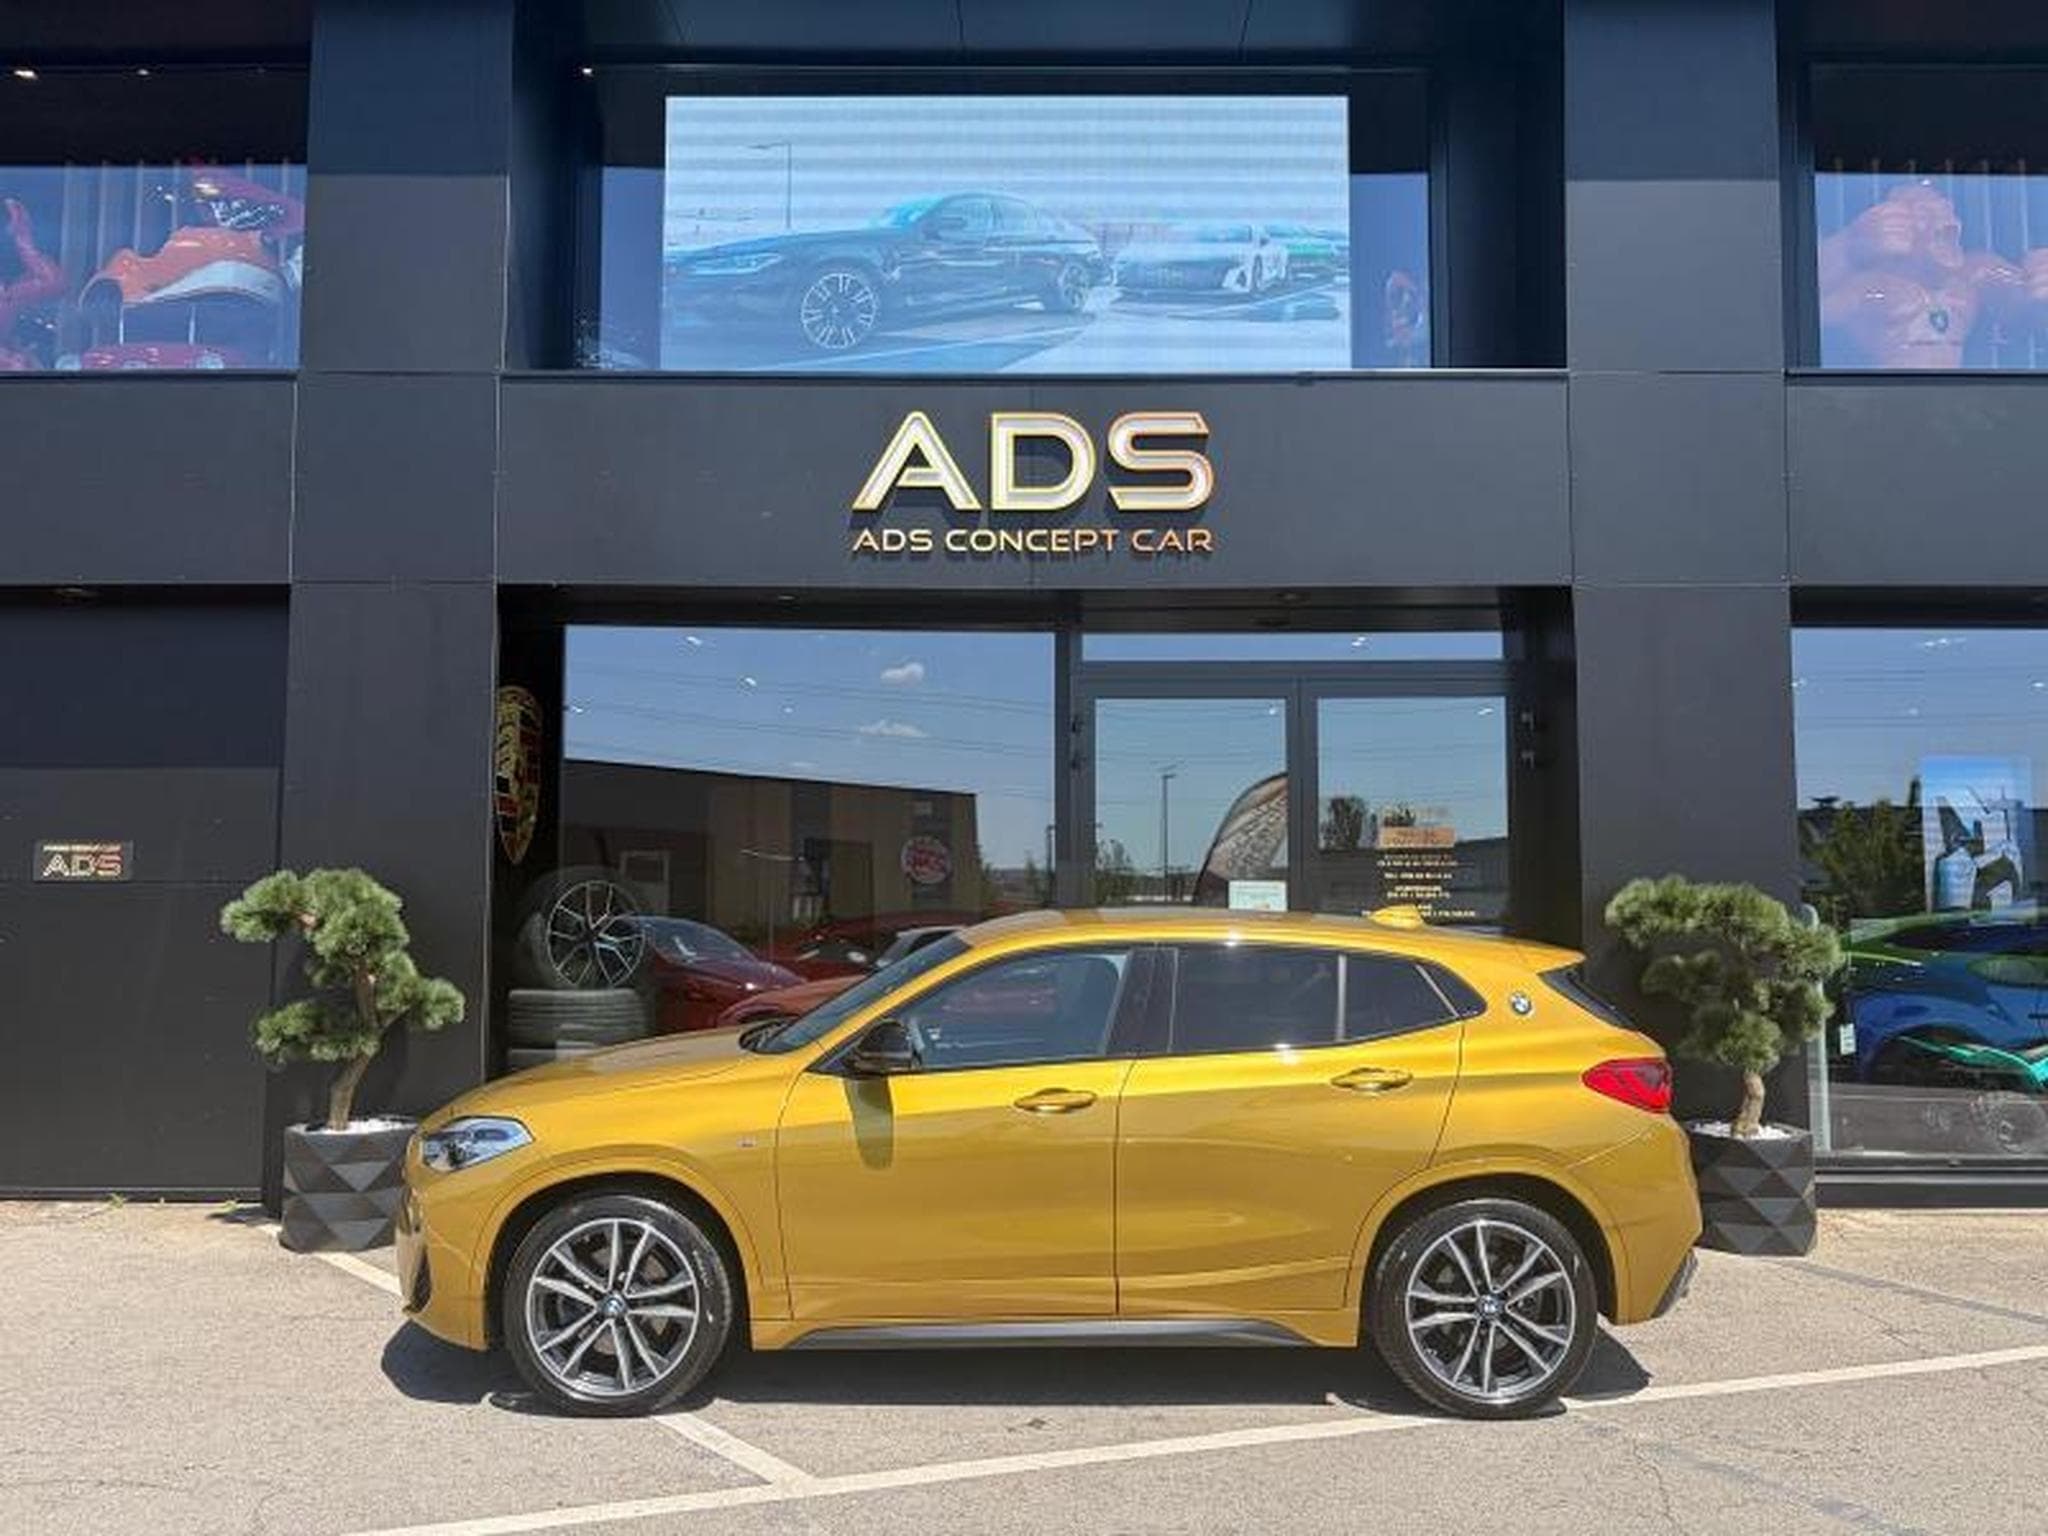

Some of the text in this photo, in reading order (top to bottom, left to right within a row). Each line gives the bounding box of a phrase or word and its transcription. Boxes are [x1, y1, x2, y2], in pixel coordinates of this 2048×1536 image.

[852, 411, 1214, 510] ADS
[853, 529, 1213, 552] ADS CONCEPT CAR
[43, 854, 122, 877] ADS
